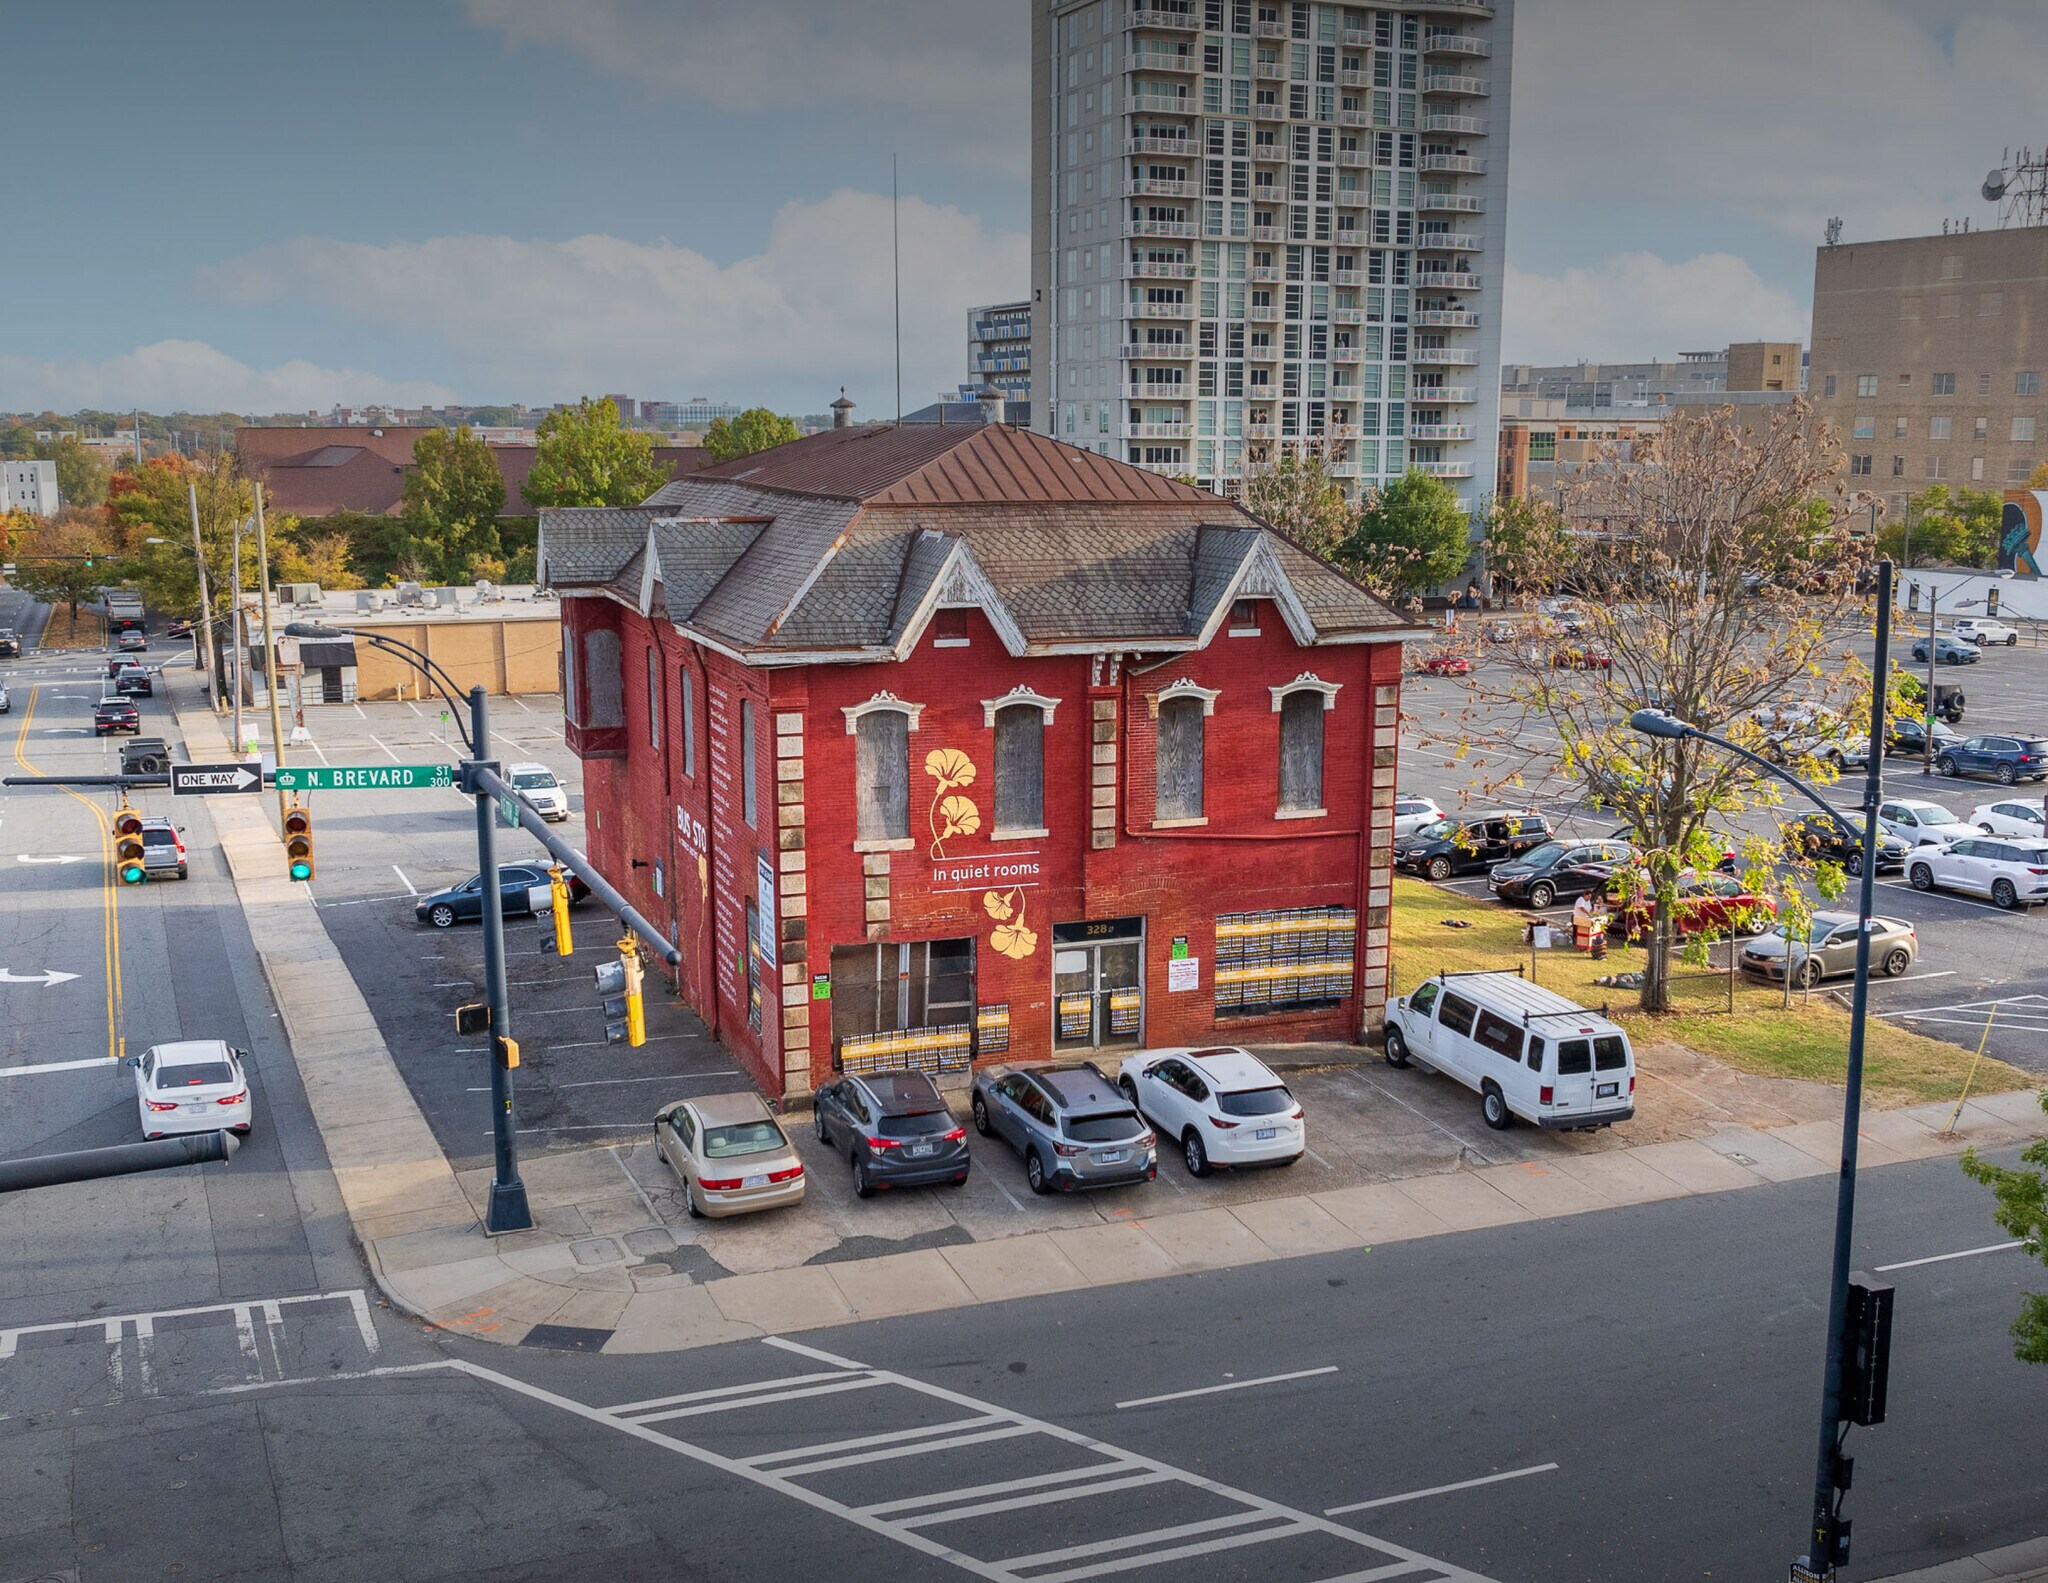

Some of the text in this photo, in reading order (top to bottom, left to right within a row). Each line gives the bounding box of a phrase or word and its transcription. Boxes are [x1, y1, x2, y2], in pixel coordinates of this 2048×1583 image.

[308, 769, 413, 787] N. BREVARD
[436, 766, 449, 776] ST
[181, 773, 235, 786] ONE WAY
[430, 777, 450, 787] 300
[677, 804, 691, 839] BUS
[692, 819, 707, 853] STO
[933, 863, 1040, 882] In quiet rooms
[1087, 924, 1108, 935] 328
[1792, 1565, 1820, 1580] ALLISON
